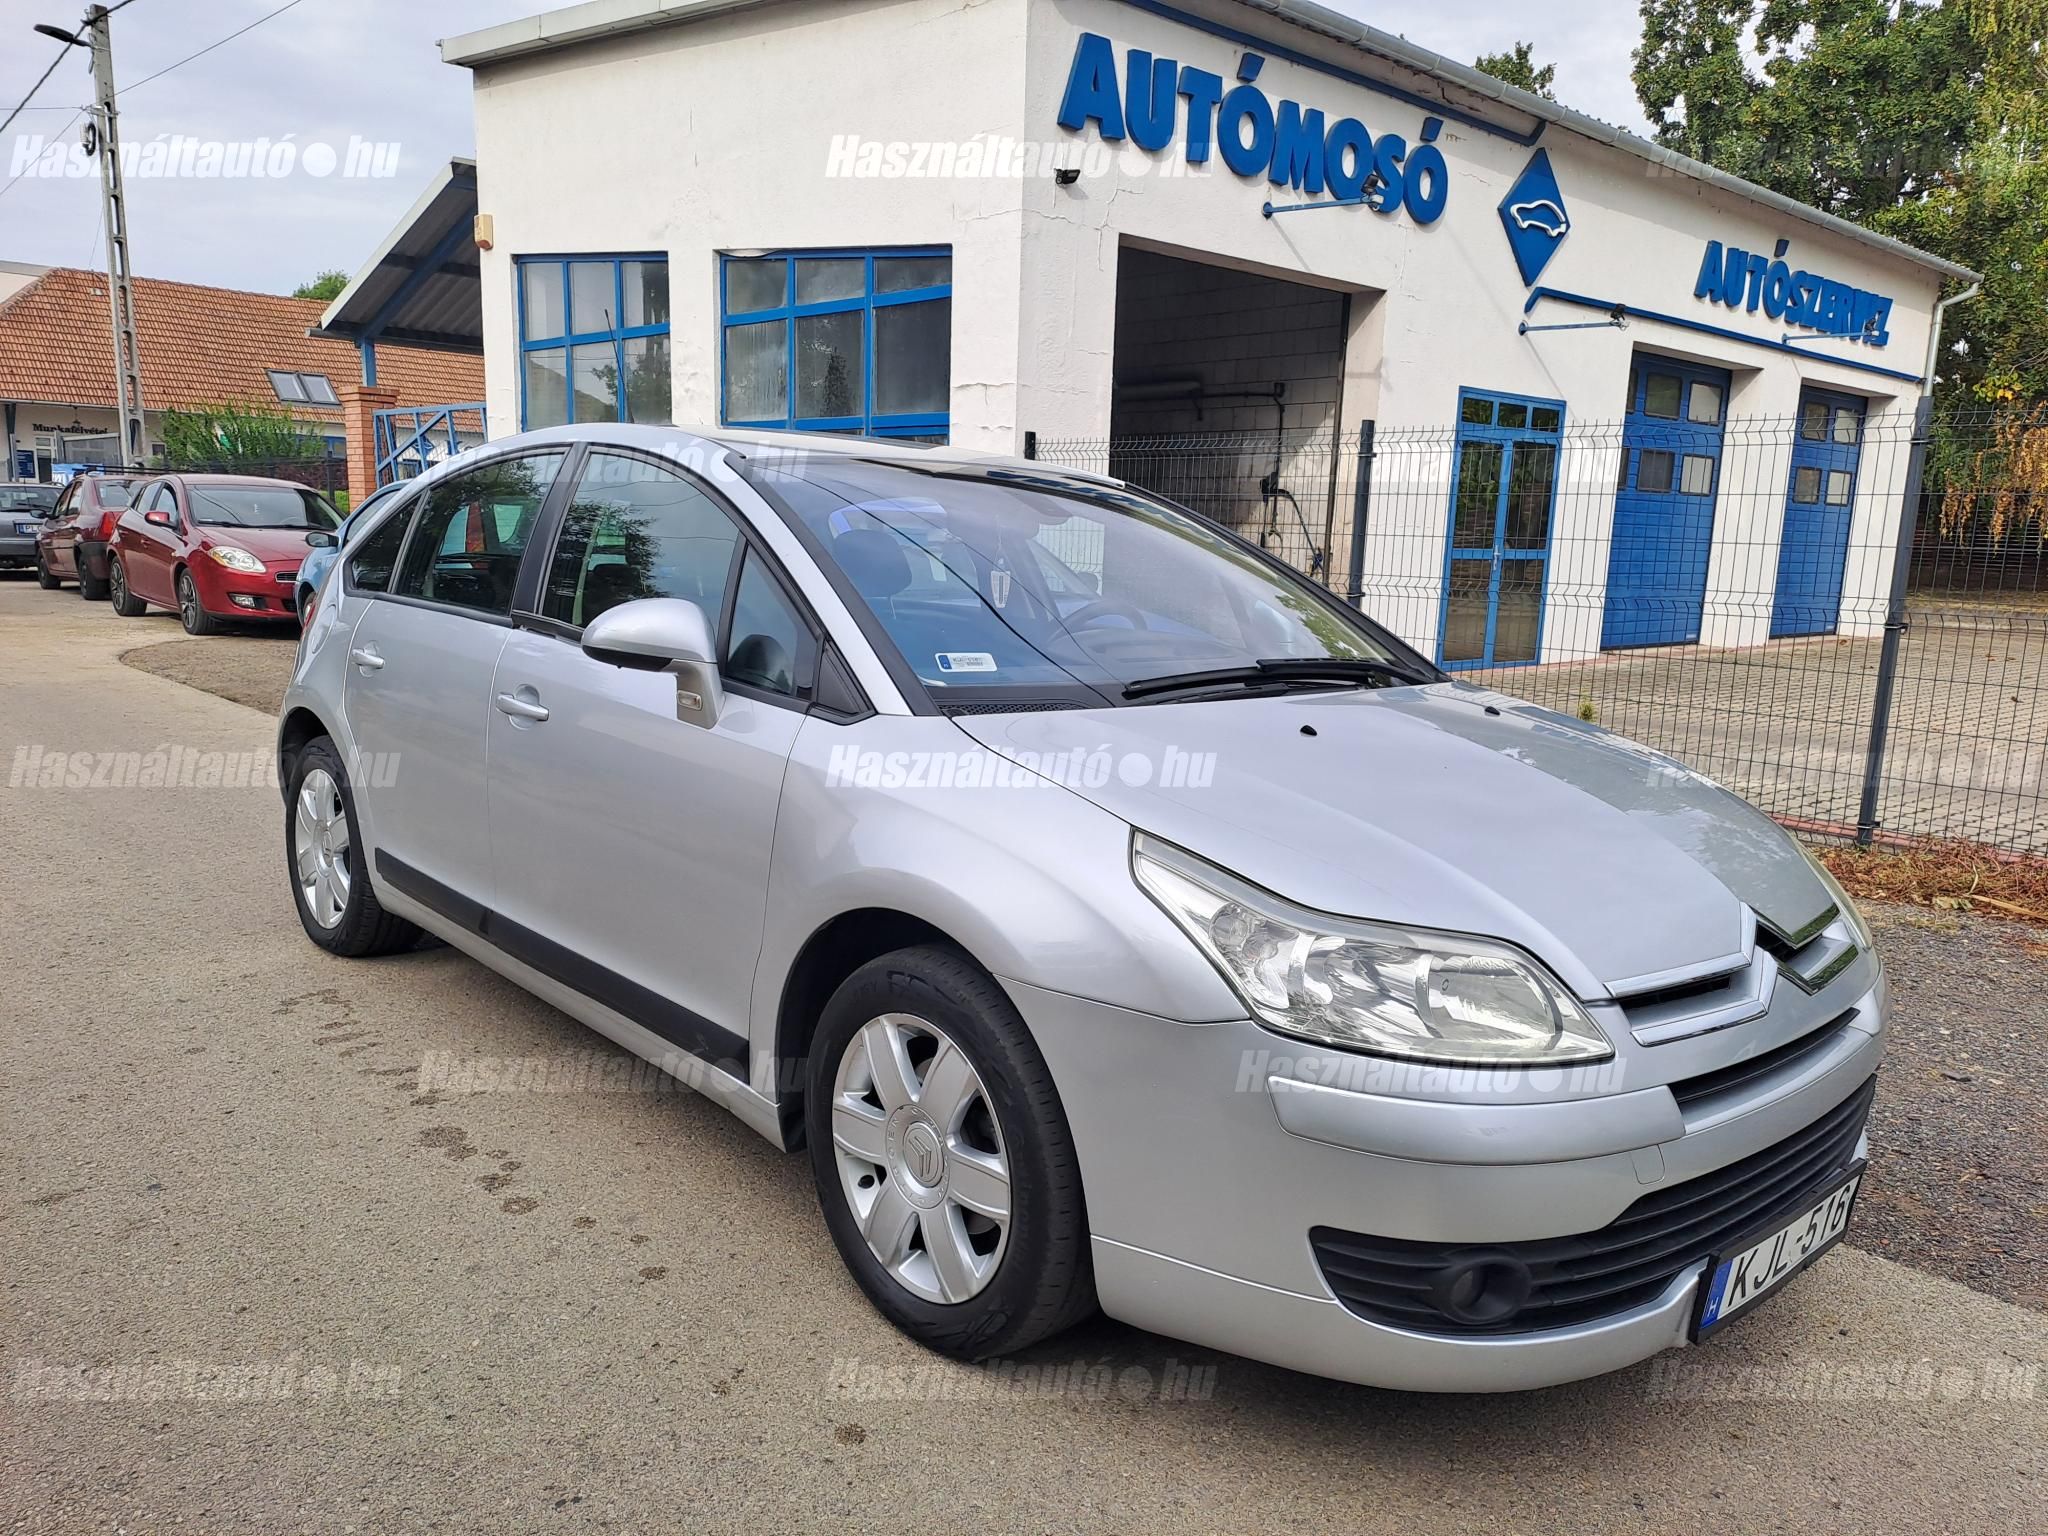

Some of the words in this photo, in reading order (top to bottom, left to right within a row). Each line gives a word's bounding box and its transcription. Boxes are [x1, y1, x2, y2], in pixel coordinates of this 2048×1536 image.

[1057, 32, 1448, 224] AUTÓMOSÓ
[1693, 238, 1893, 347] AUTÓSZERVIZ
[1728, 1184, 1850, 1308] KJL-516
[1708, 1298, 1719, 1318] H
